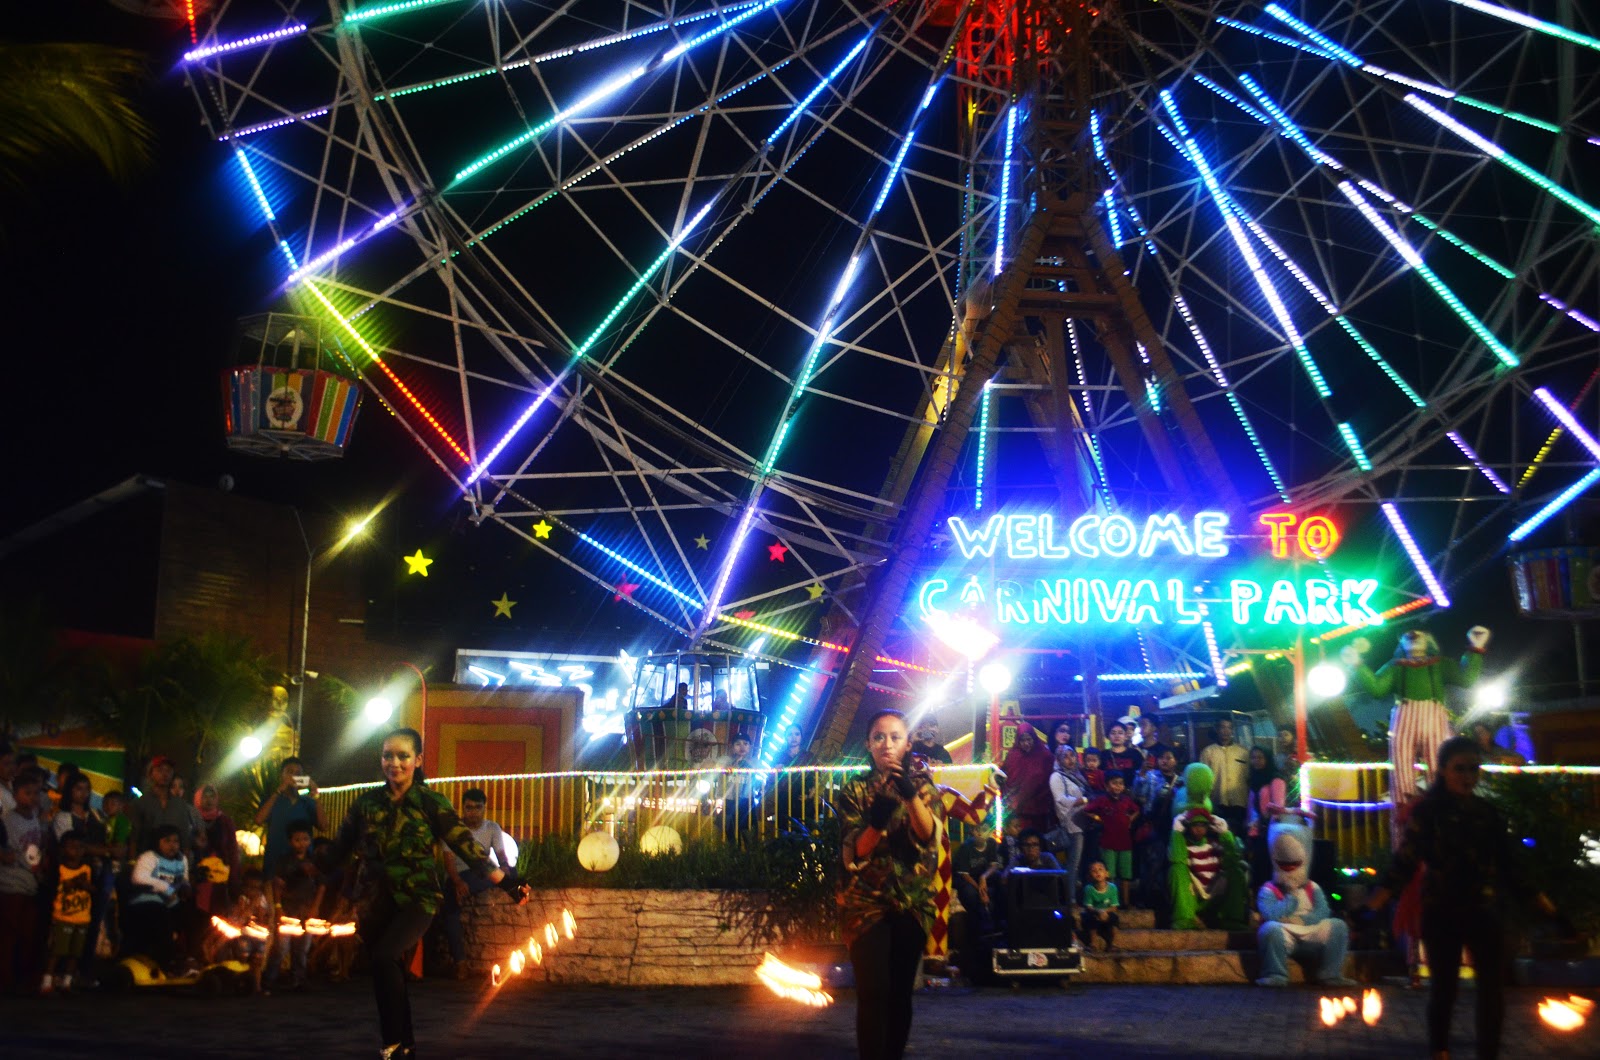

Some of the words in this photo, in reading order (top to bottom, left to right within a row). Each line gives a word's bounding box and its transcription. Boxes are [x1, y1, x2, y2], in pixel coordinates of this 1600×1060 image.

[947, 512, 1229, 559] WELCOME
[1260, 513, 1338, 560] TO
[1230, 579, 1384, 626] PARK
